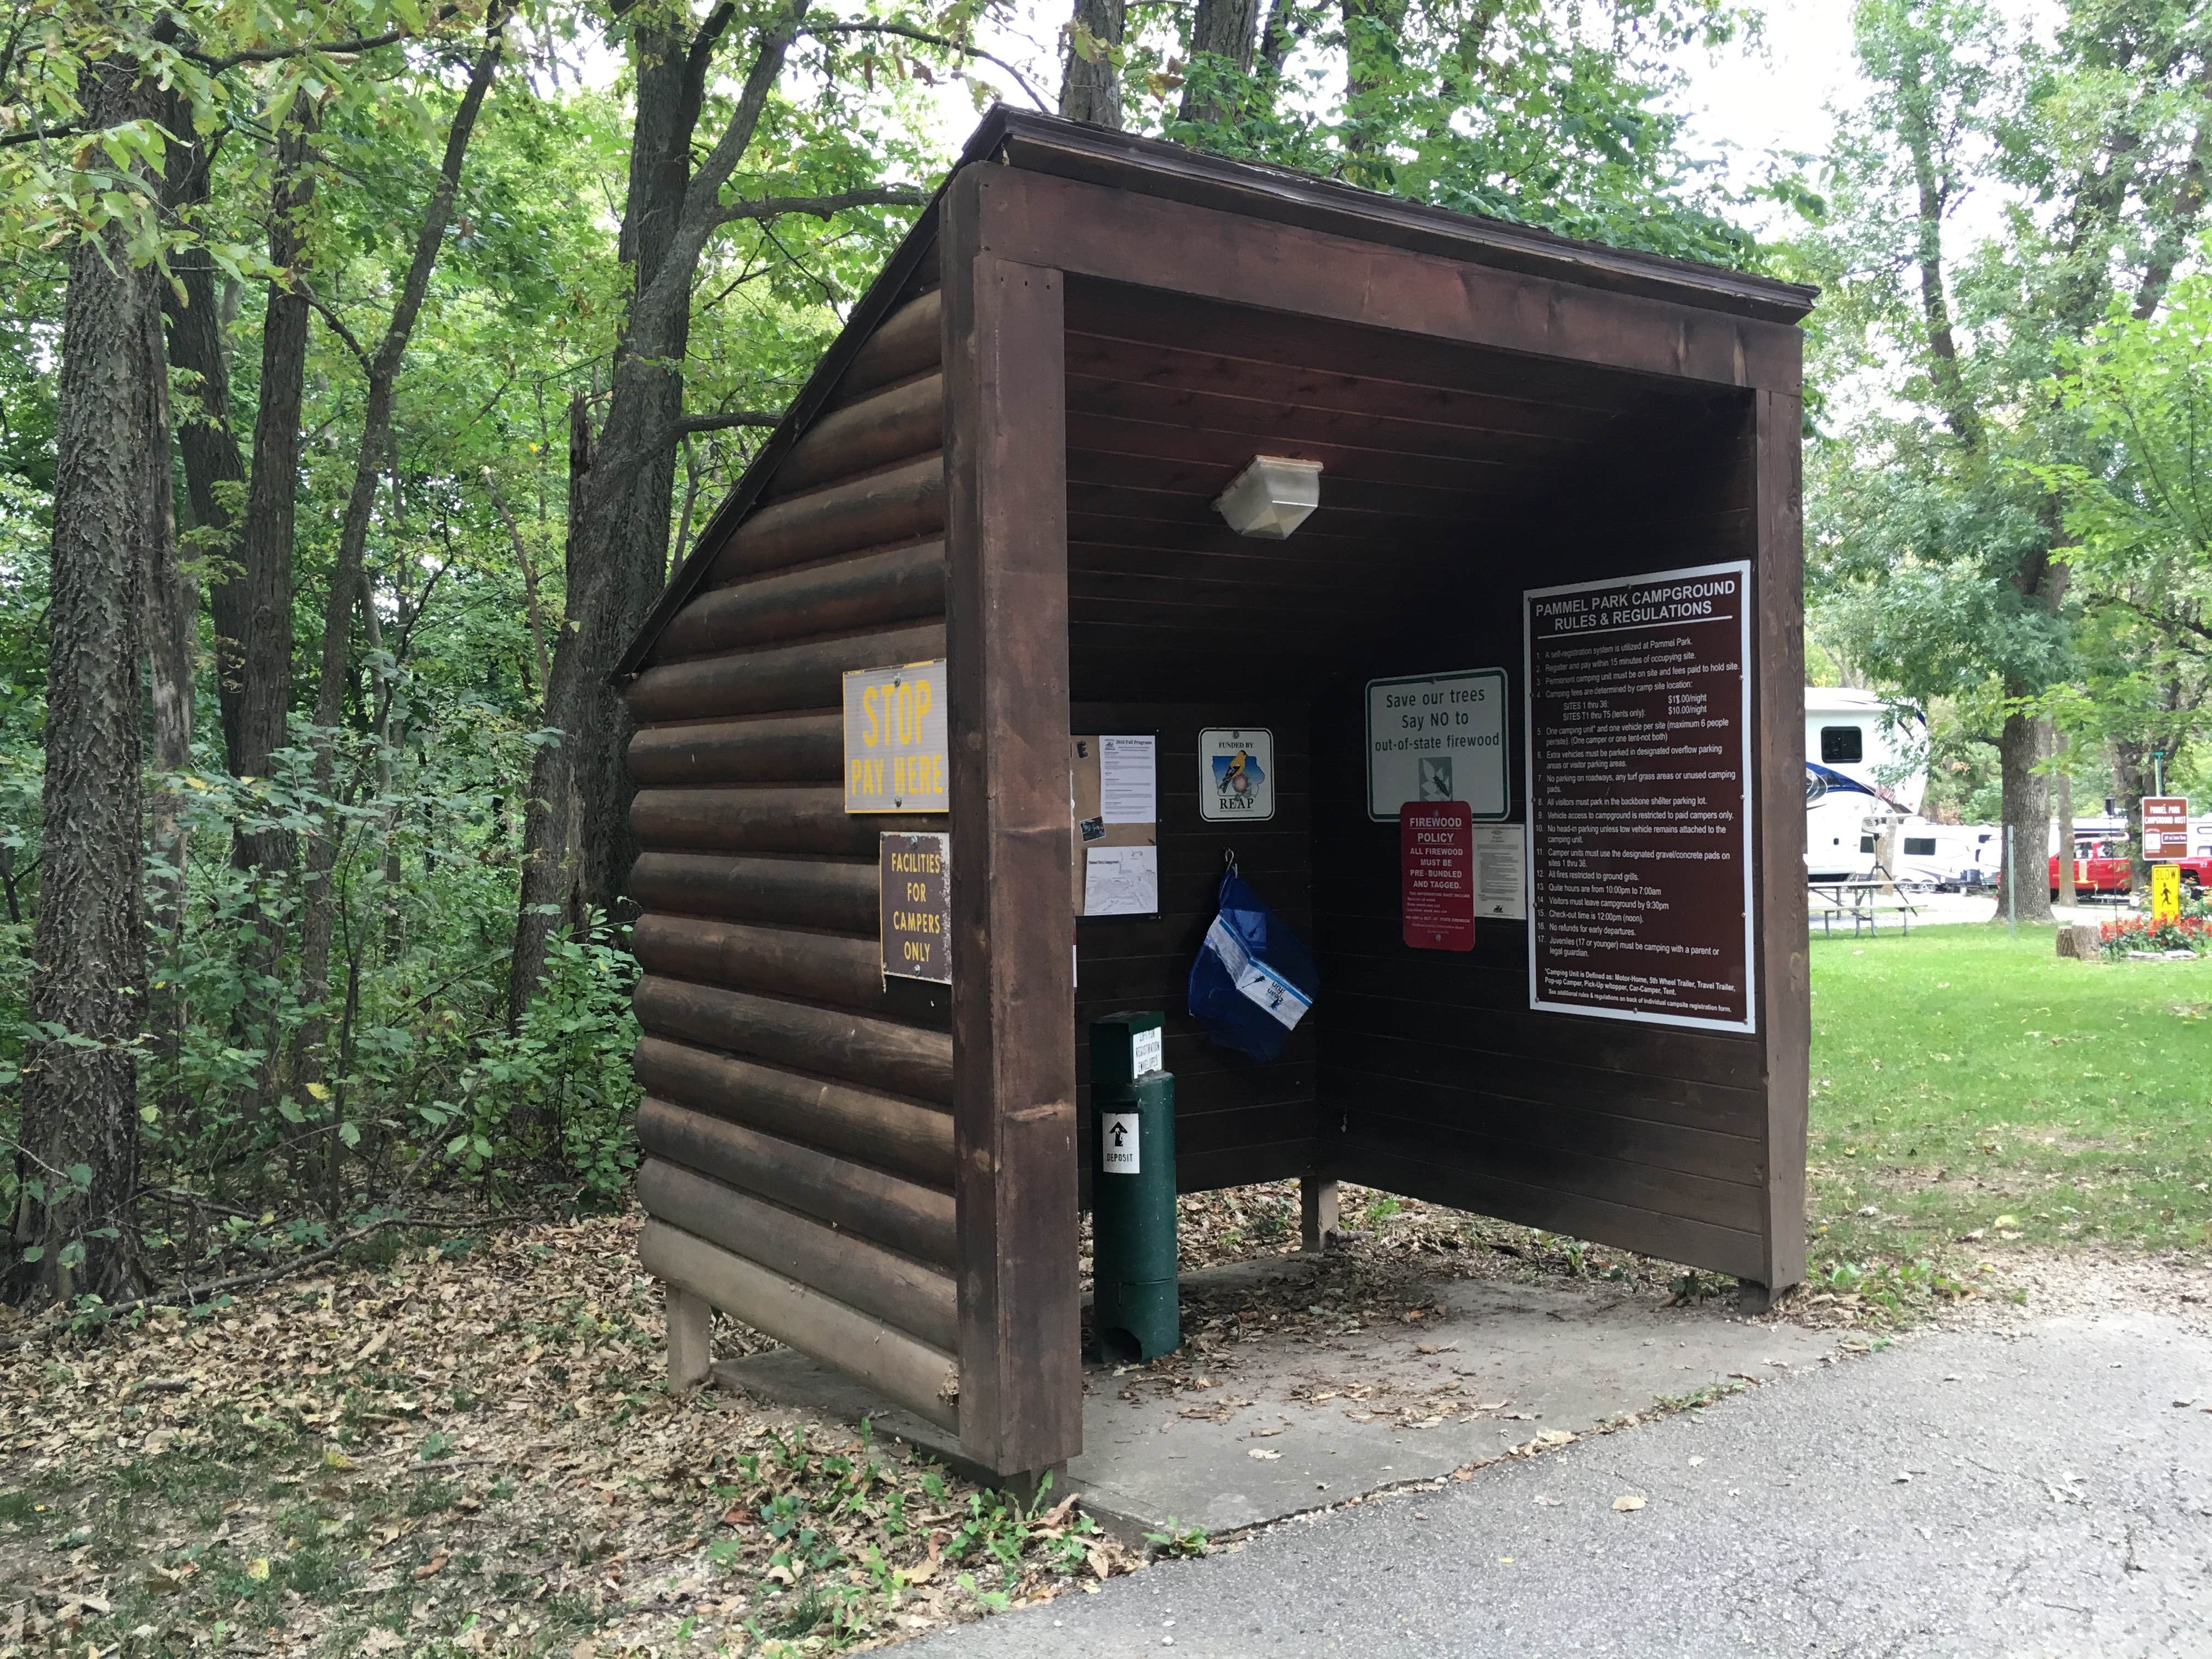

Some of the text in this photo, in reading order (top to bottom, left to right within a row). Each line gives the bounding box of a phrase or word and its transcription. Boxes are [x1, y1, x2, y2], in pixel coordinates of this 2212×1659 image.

[1536, 579, 1735, 617] PAMMEL PARK CAMPGROUND
[1555, 600, 1712, 630] RULES & REGULATIONS
[1621, 641, 1641, 652] utilized
[1643, 641, 1649, 650] at
[1650, 638, 1675, 648] Pammel
[1610, 657, 1618, 666] 15
[1618, 656, 1642, 665] minutes
[1643, 654, 1650, 663] of
[1650, 652, 1681, 664] occupying
[1628, 670, 1637, 678] be
[1646, 668, 1657, 677] site
[1659, 667, 1671, 676] and
[1672, 665, 1685, 675] fees
[1687, 664, 1701, 675] paid
[1702, 664, 1708, 673] to
[1710, 662, 1724, 672] hold
[1627, 684, 1635, 694] by
[1636, 684, 1653, 693] camp
[1654, 681, 1665, 690] site
[1386, 689, 1485, 708] Save our trees
[862, 679, 931, 748] STOP
[1612, 709, 1628, 719] (tents
[1402, 711, 1469, 731] Say NO to
[1621, 718, 1729, 731] vehicle per site (maximum 6 people
[1375, 732, 1499, 752] out-of-state firewood
[1652, 732, 1667, 742] both)
[1637, 744, 1722, 757] designated overflow parking
[851, 754, 943, 796] PAY HERE
[1627, 772, 1638, 780] turf
[1638, 773, 1655, 782] grass
[1683, 770, 1706, 779] unused
[1707, 769, 1735, 780] camping
[1219, 798, 1254, 809] REAP
[1610, 797, 1620, 805] the
[1621, 797, 1650, 805] backbone
[1673, 796, 1696, 806] parking
[1409, 817, 1462, 827] FIREWOOD
[1667, 811, 1673, 819] to
[1675, 810, 1688, 820] paid
[1690, 812, 1717, 821] campers
[1631, 825, 1652, 833] vehicle
[1653, 825, 1678, 833] remains
[1679, 825, 1706, 833] attached
[1707, 825, 1714, 833] to
[1716, 825, 1726, 833] the
[1418, 833, 1454, 843] POLICY
[1425, 848, 1463, 856] FIREWOOD
[1622, 849, 1654, 860] designated
[1704, 851, 1720, 861] pads
[891, 853, 940, 874] FACILITIES
[2155, 869, 2176, 880] SLOW
[1430, 881, 1461, 889] TAGGED.
[1639, 886, 1661, 895] 7:00am
[907, 882, 927, 902] FOR
[1637, 900, 1645, 910] by
[1646, 900, 1669, 911] 9:30pm
[893, 911, 940, 934] CAMPERS
[904, 941, 930, 962] ONLY
[1620, 941, 1634, 950] must
[1635, 941, 1643, 950] be
[1644, 942, 1669, 954] camping
[1671, 944, 1684, 953] with
[1690, 946, 1711, 957] parent
[1136, 1040, 1160, 1058] REGISTRATION
[1138, 1054, 1158, 1073] ENVELOPES
[1107, 1153, 1133, 1162] DEPOSIT
